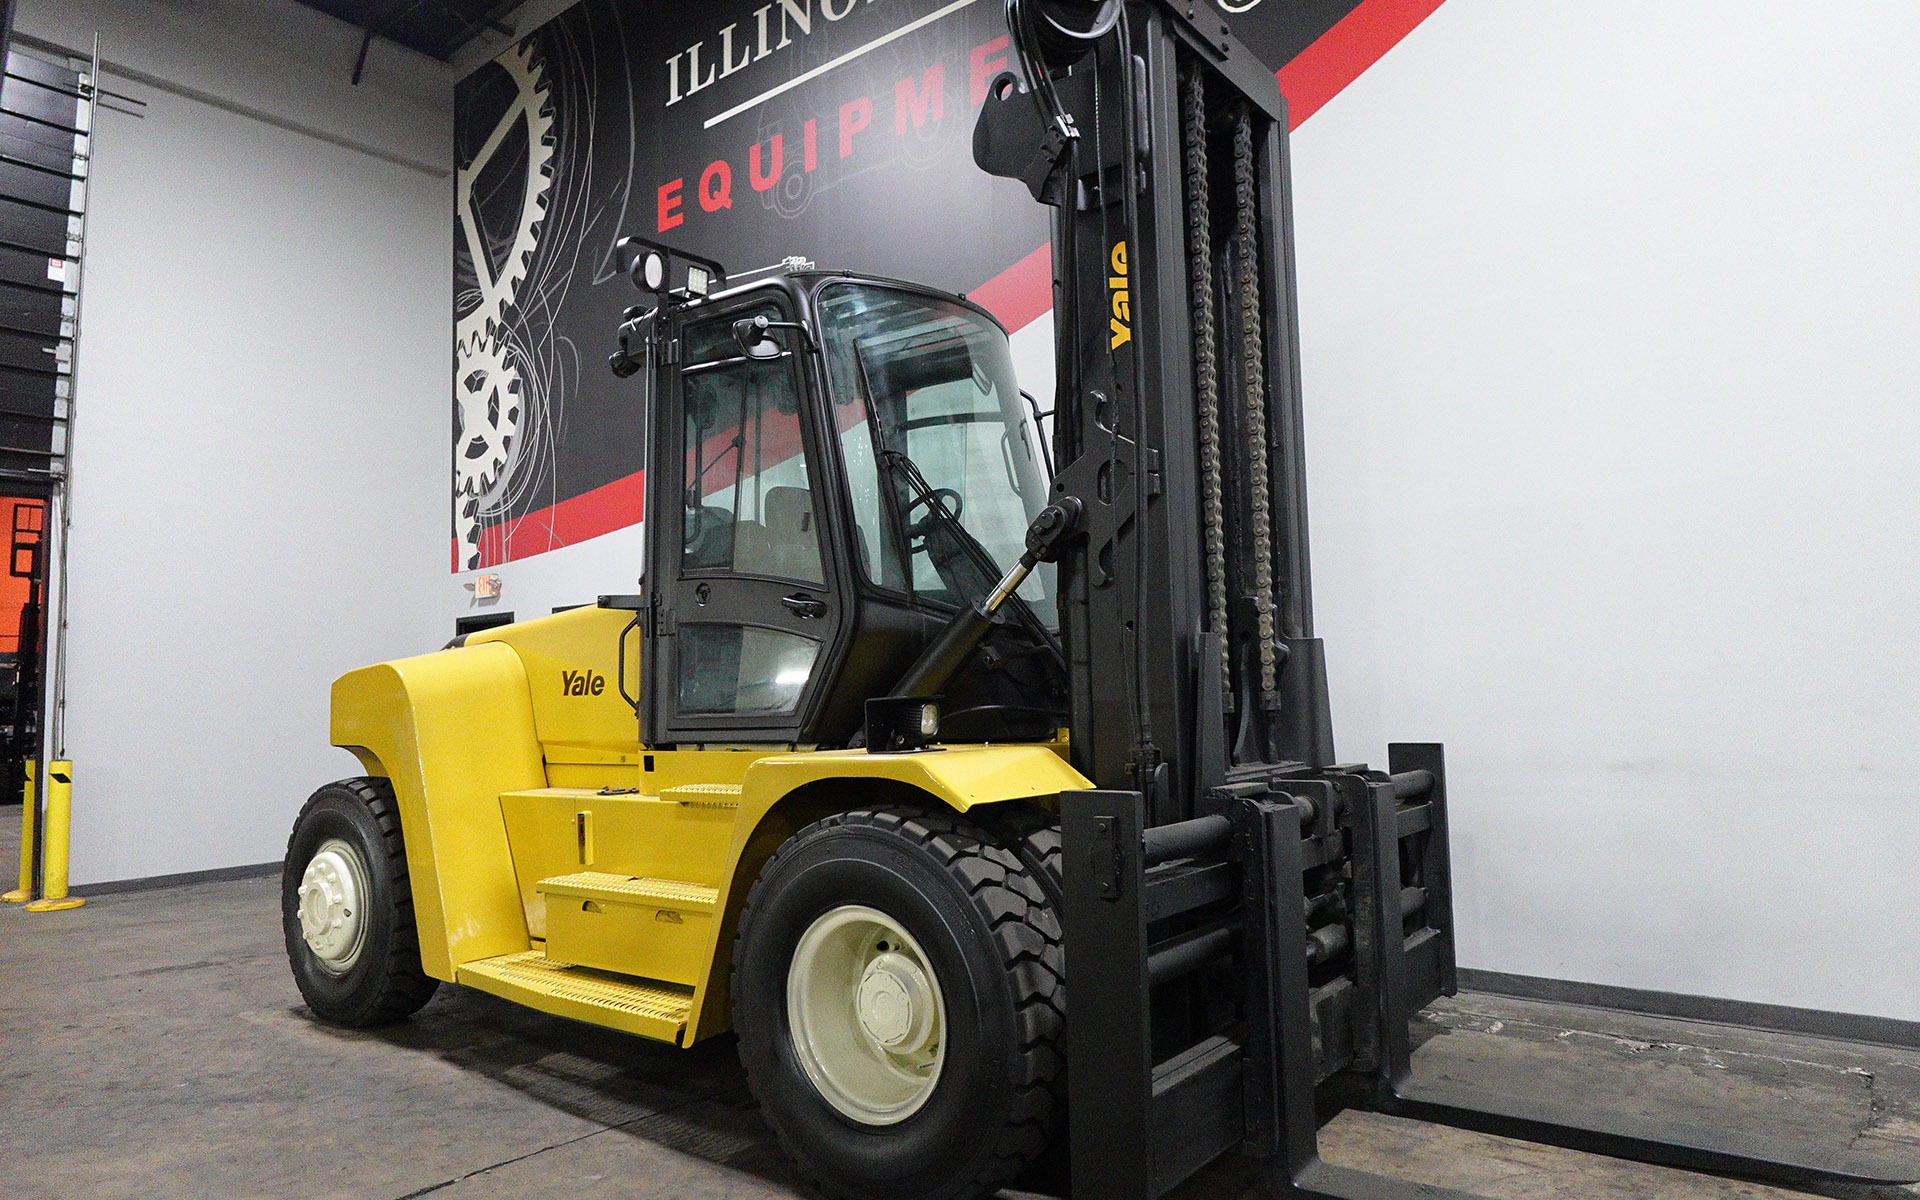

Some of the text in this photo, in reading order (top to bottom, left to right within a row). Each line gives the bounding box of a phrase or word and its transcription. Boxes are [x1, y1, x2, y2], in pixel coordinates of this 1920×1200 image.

[665, 0, 881, 107] ILLIN
[657, 35, 1043, 233] EQUIPME
[1109, 240, 1131, 350] Yale
[562, 669, 605, 696] Yale
